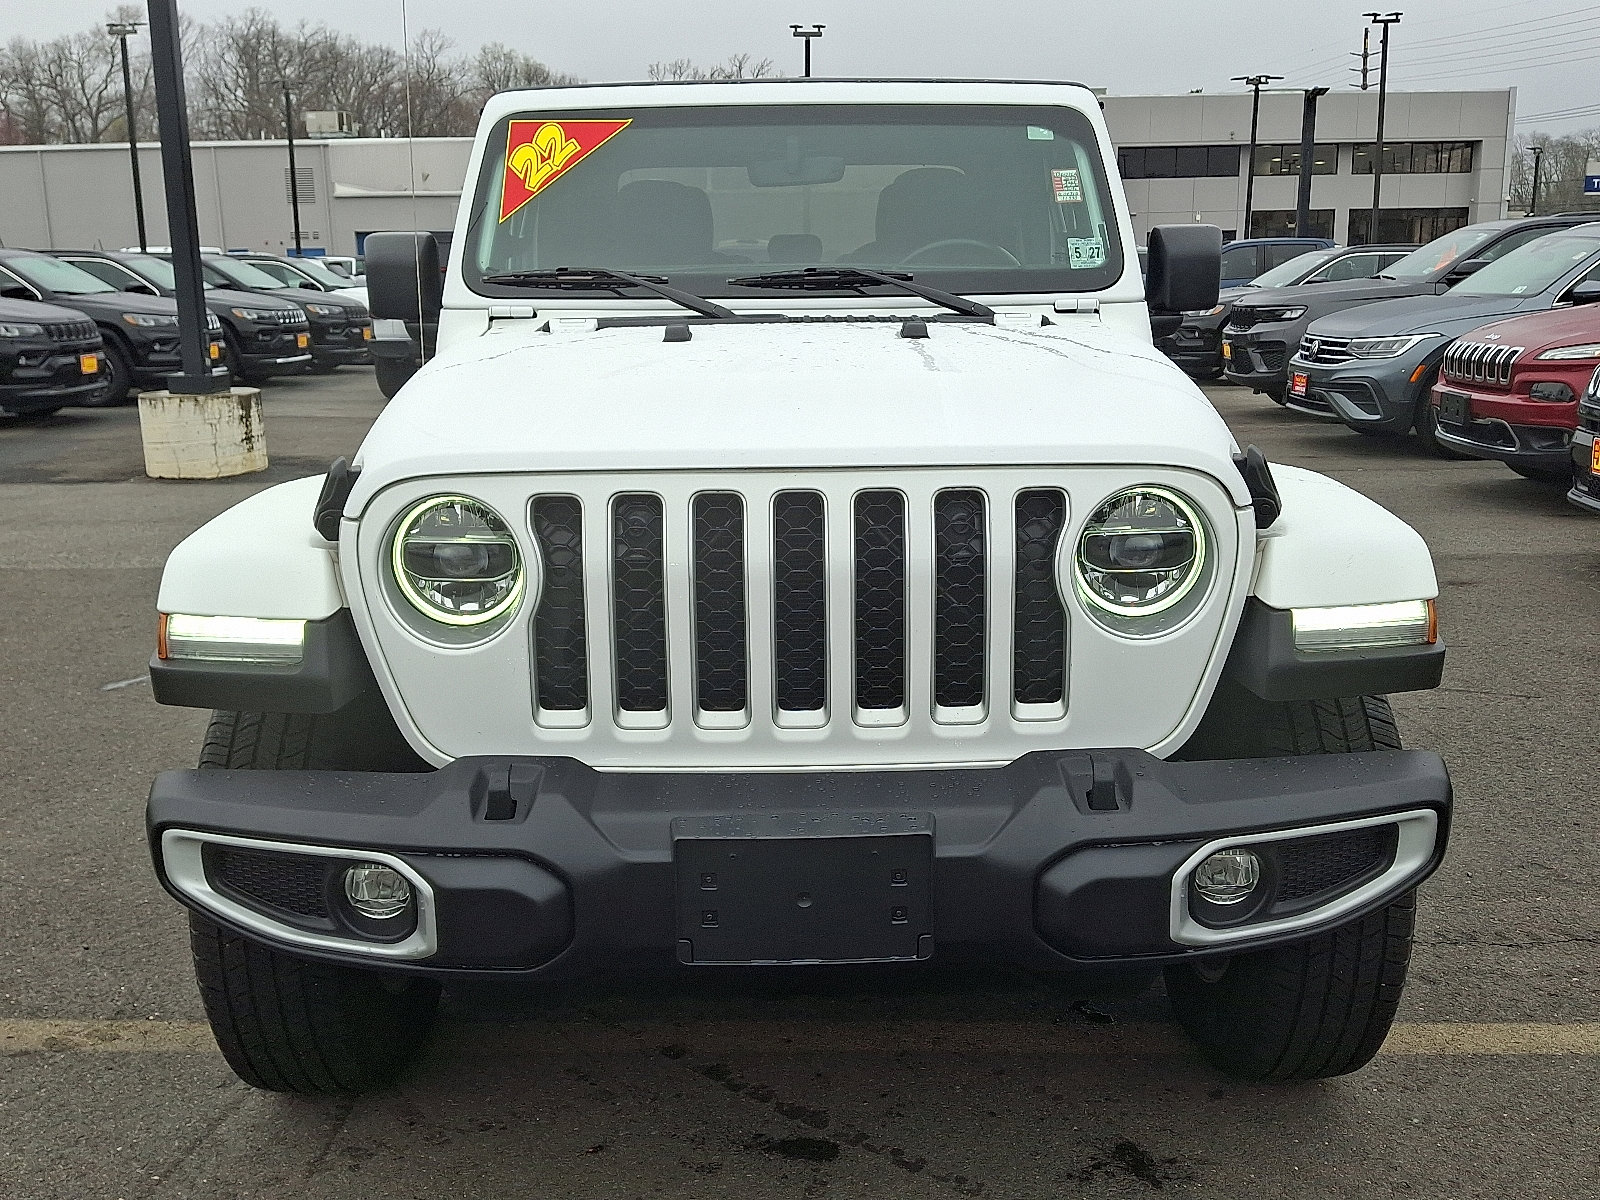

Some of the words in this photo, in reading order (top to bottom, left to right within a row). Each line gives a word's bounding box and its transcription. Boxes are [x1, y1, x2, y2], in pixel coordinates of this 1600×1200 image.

[508, 121, 582, 192] 22
[1074, 247, 1081, 259] 5
[1089, 246, 1100, 259] 27
